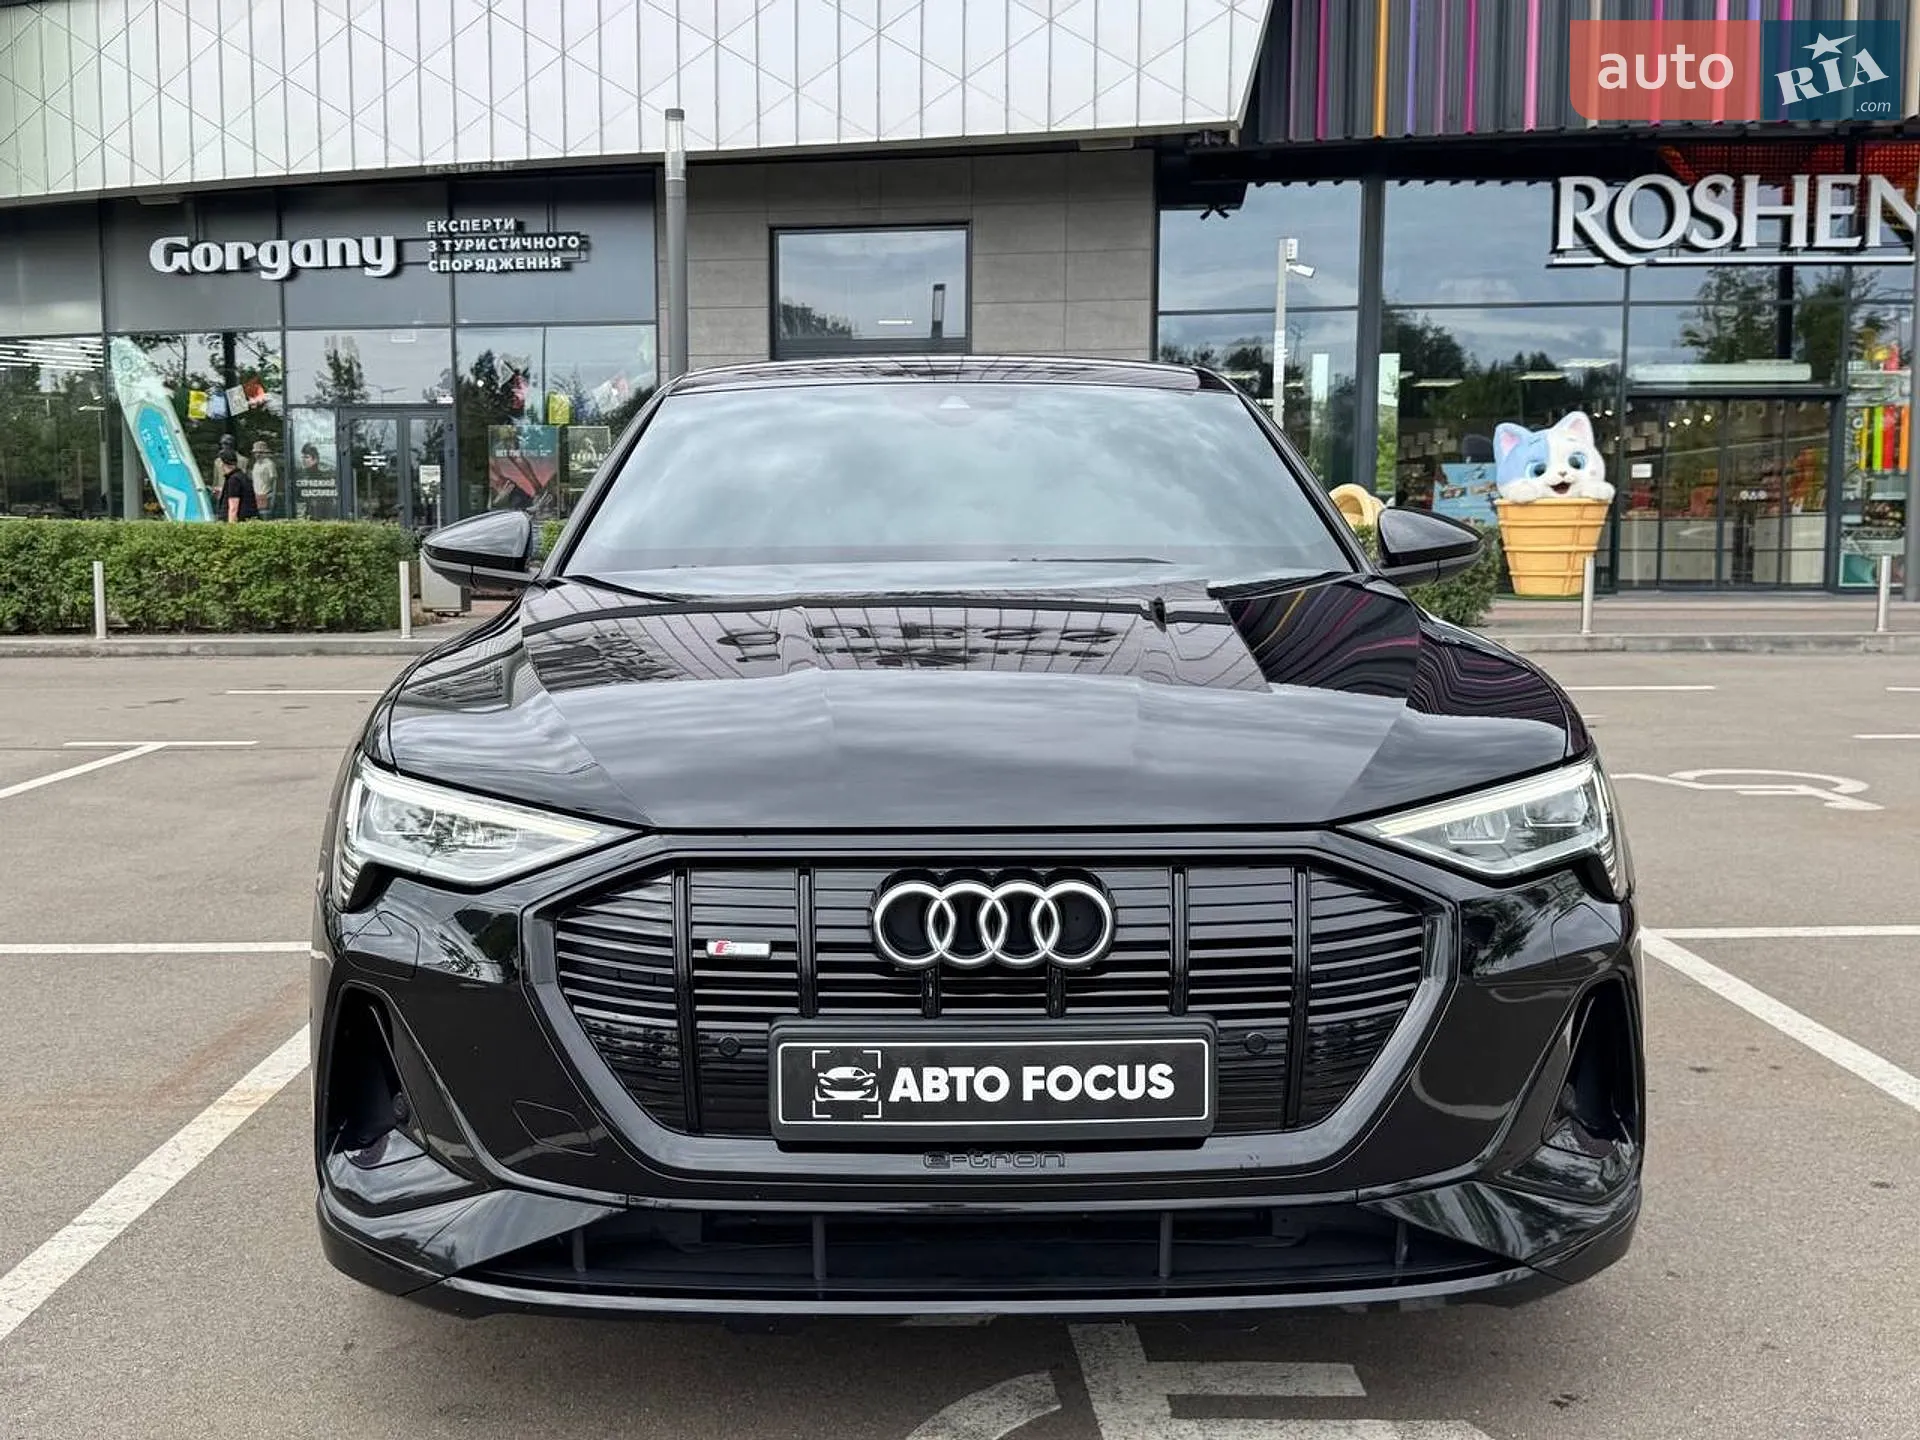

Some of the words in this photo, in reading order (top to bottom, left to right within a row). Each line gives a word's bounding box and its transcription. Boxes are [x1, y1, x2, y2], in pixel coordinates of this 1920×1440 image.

[427, 218, 516, 233] ЕКСПЕРТИ
[443, 236, 580, 252] ТУРИСТИЧНОГО
[149, 235, 397, 281] Gorgany
[428, 256, 562, 272] СПОРЯДЖЕННЯ
[1022, 1063, 1175, 1102] FOCUS
[922, 1149, 1066, 1169] e-tron
